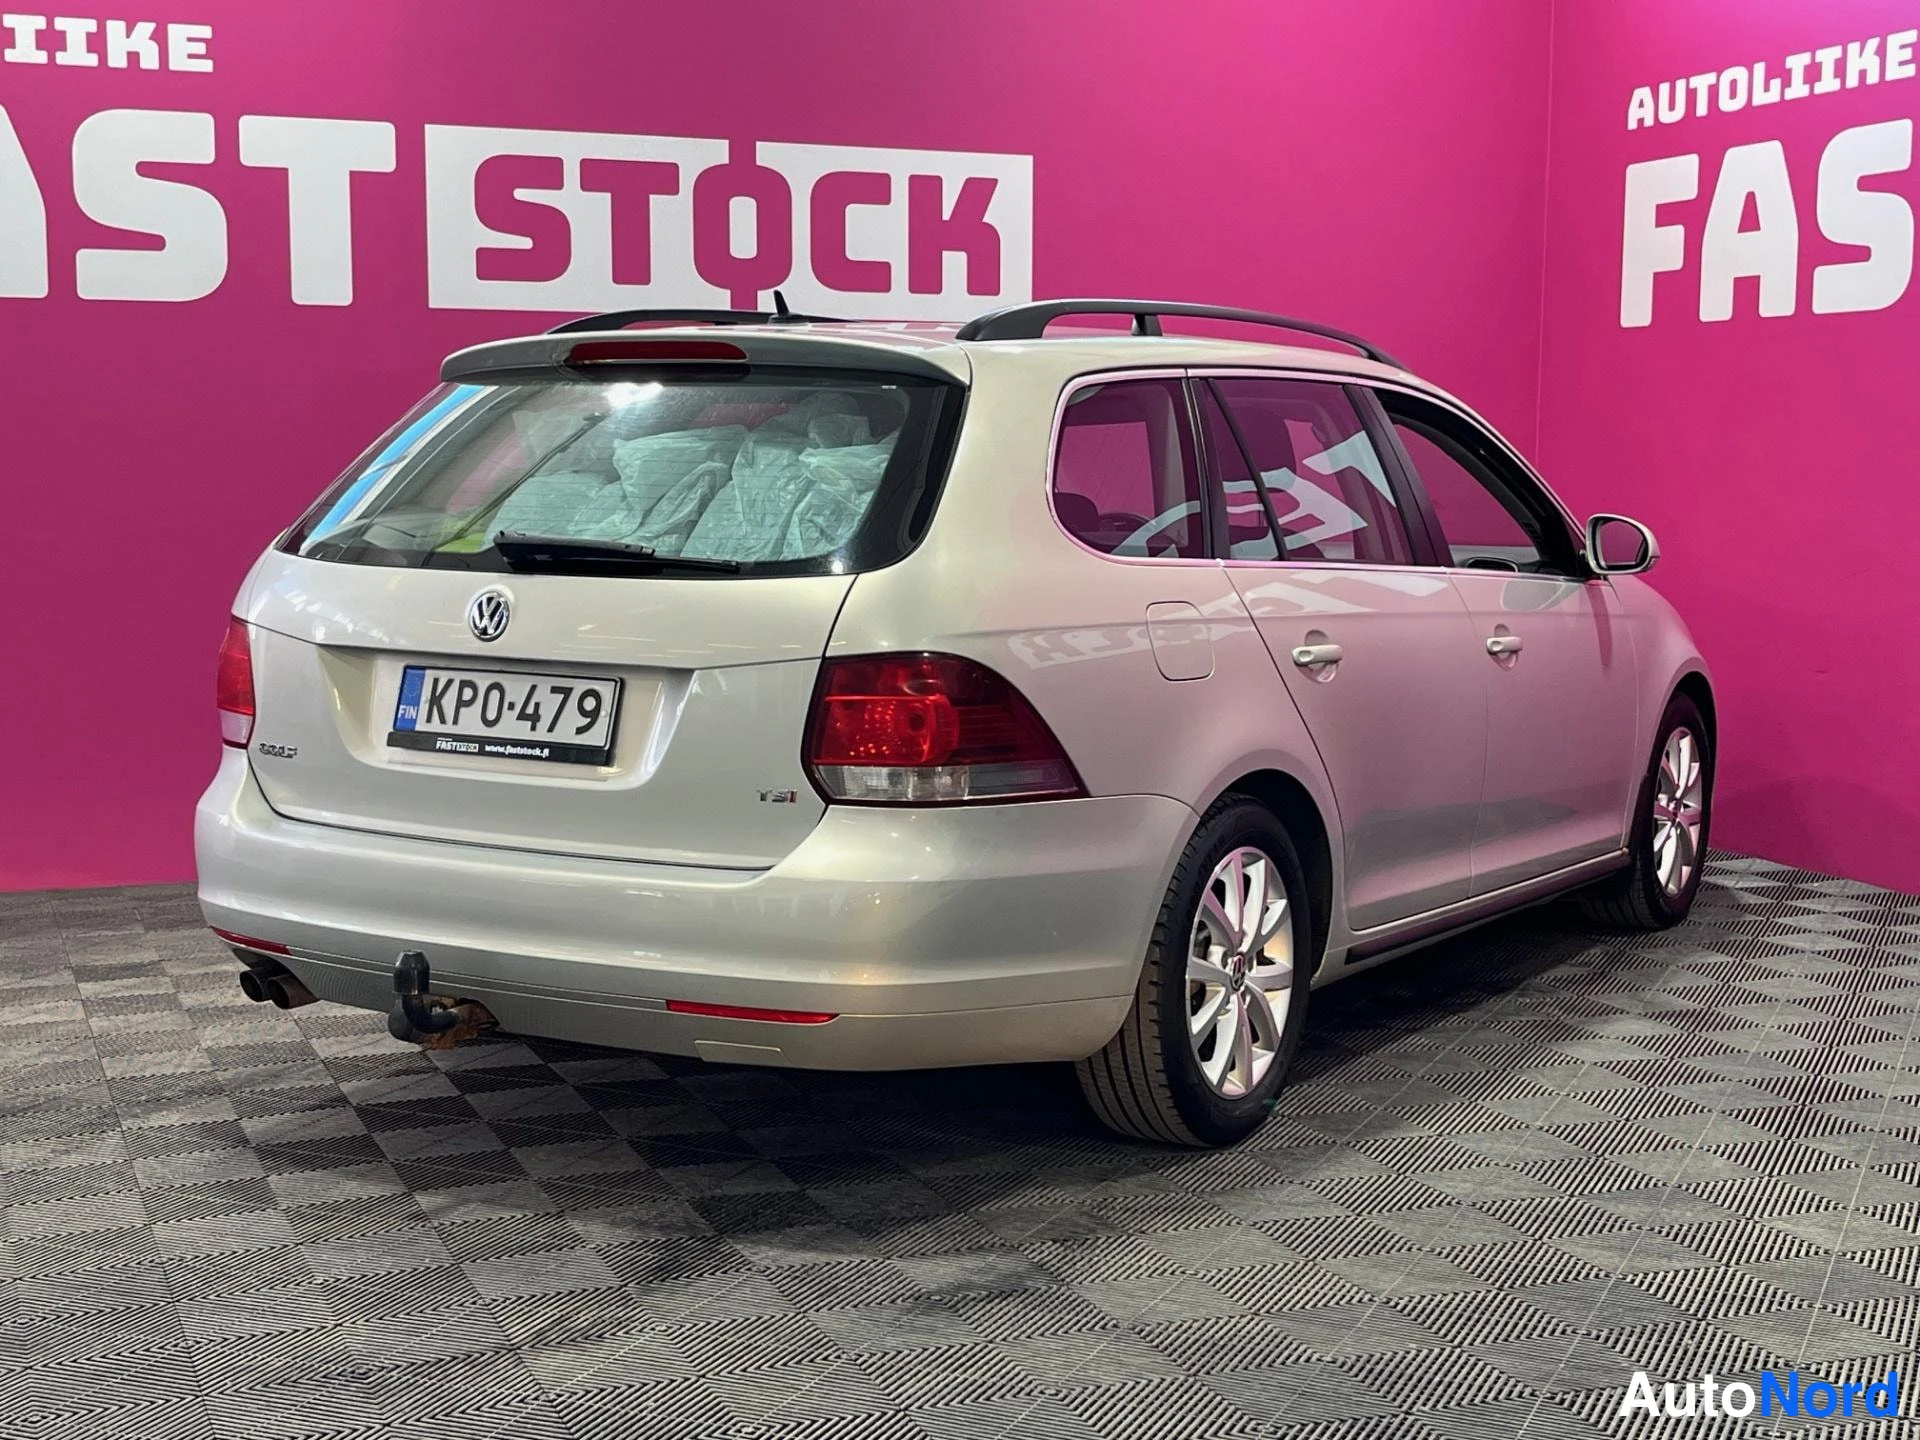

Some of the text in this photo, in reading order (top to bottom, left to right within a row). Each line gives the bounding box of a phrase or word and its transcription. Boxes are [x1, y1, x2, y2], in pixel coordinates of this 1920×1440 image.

[2, 13, 214, 72] IIKE
[1626, 28, 1918, 130] AUTOLIIKE
[0, 104, 1001, 307] ST STOCK
[1619, 118, 1915, 329] FAS
[398, 705, 417, 720] FIN
[425, 677, 603, 735] KPO-479
